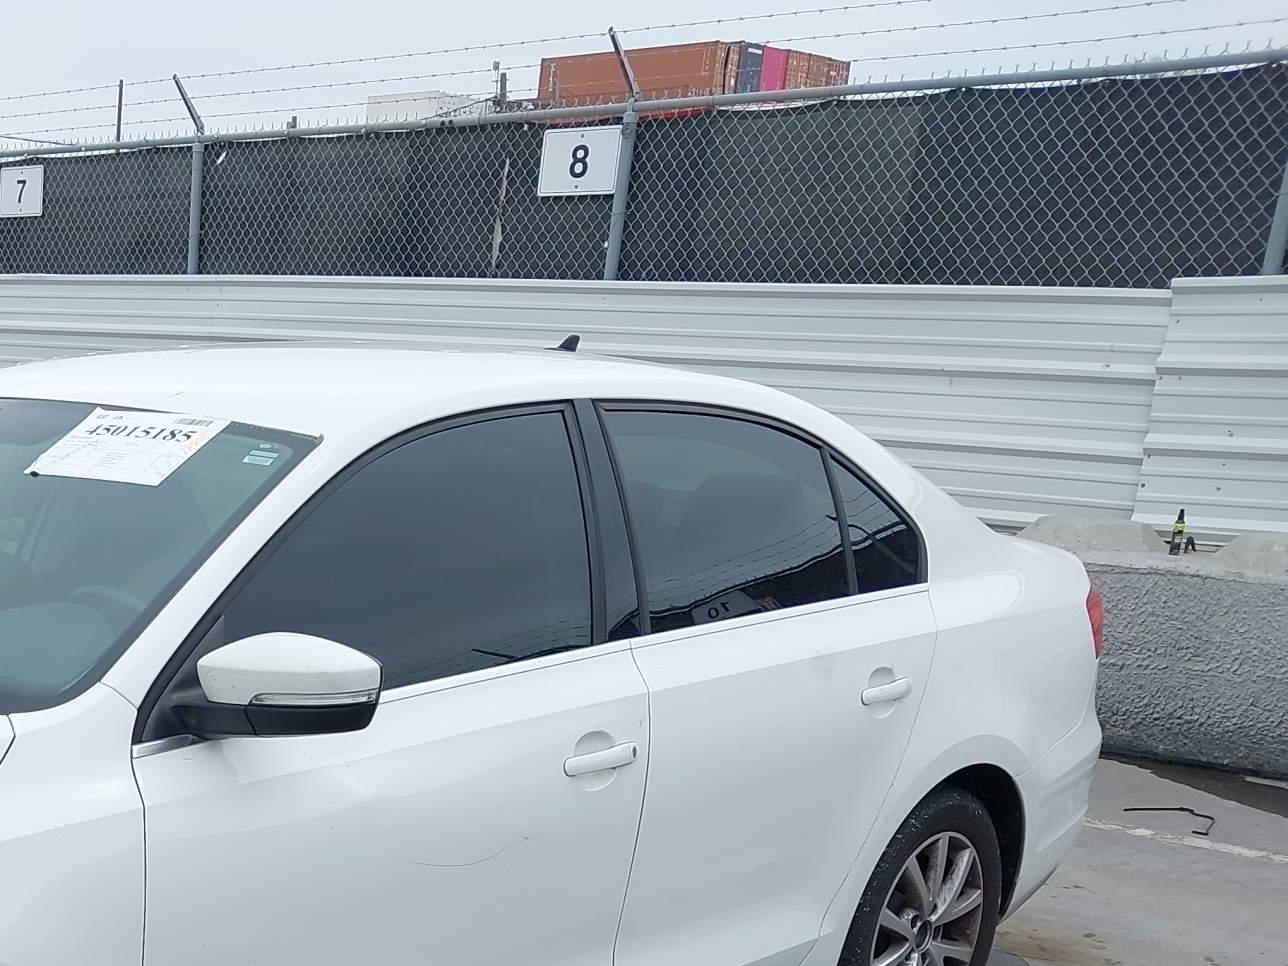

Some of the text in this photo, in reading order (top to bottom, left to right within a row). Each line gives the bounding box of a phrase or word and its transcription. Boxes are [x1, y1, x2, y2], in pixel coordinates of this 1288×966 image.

[569, 144, 590, 179] 8
[16, 179, 27, 204] 7
[85, 423, 198, 443] 45015185
